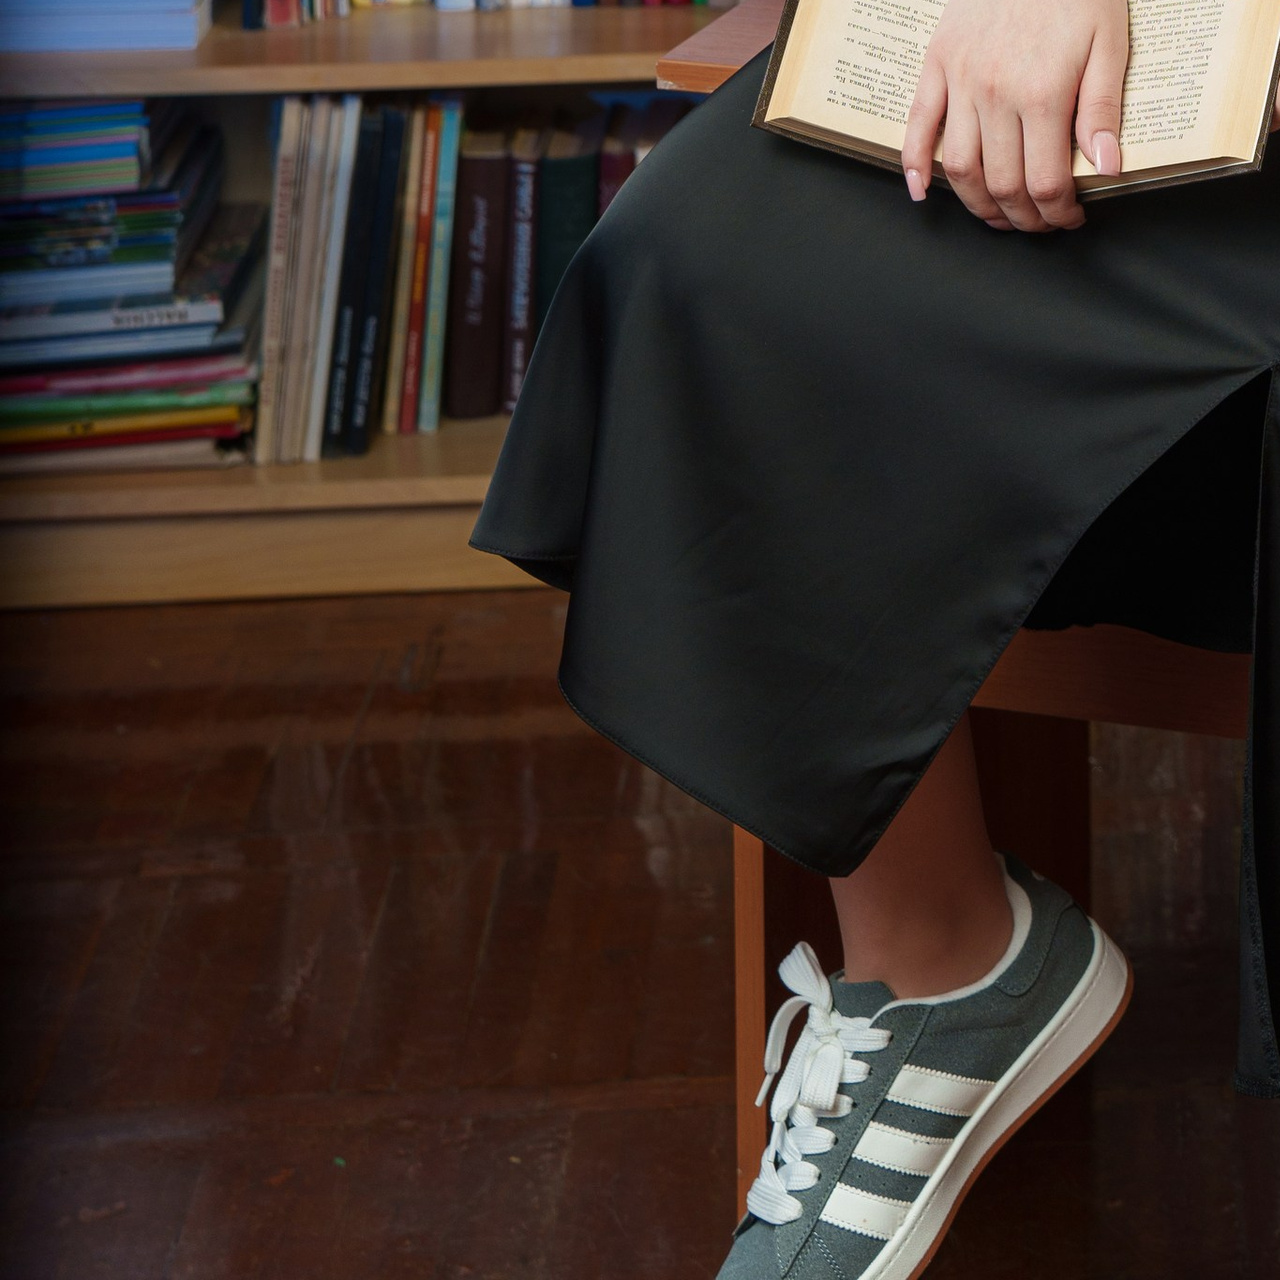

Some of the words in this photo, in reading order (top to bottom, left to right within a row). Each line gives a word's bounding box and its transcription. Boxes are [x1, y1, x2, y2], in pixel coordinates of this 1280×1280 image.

[879, 0, 911, 12] развитее
[876, 14, 917, 32] Сумрачный
[894, 10, 928, 26] товарищу
[847, 21, 871, 32] сказал
[857, 40, 896, 56] попробуют
[888, 57, 917, 70] отвечал
[848, 78, 875, 92] Ортика
[877, 87, 907, 100] прервал
